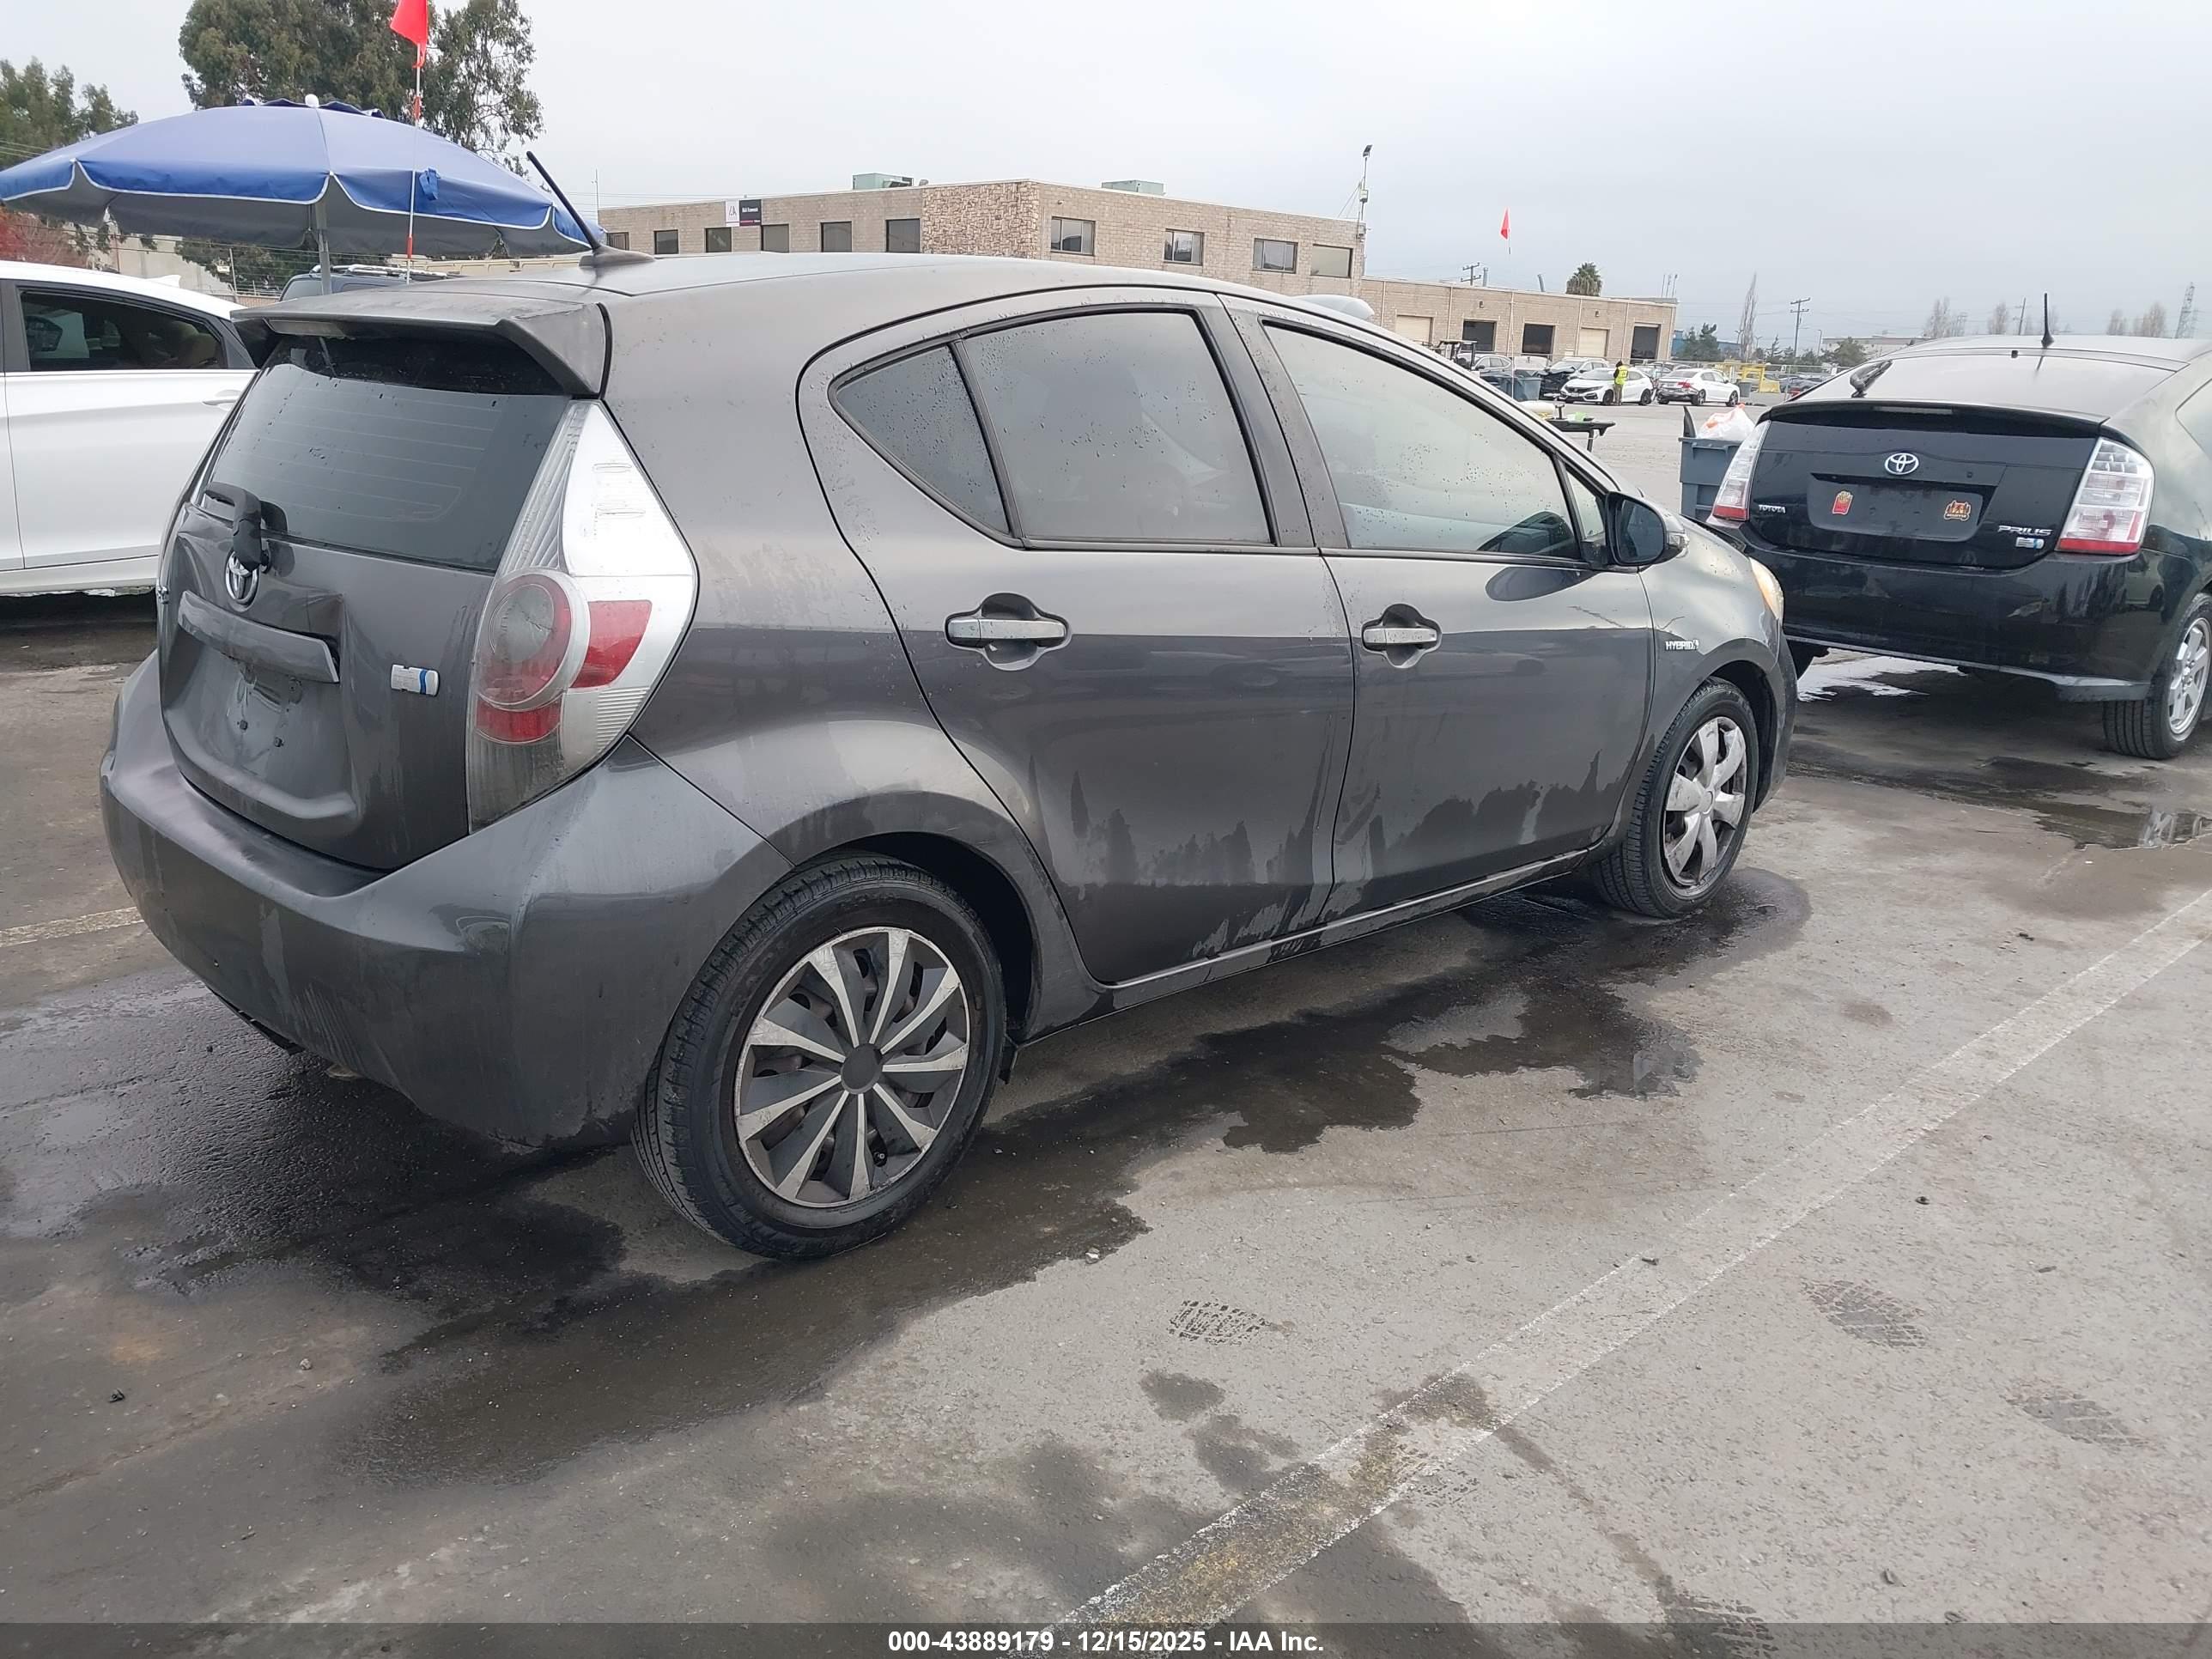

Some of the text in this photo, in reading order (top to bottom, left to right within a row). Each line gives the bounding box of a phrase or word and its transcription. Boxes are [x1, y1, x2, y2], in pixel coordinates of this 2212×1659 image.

[1758, 504, 1786, 514] TOYOTA
[1997, 525, 2054, 537] PRIUS
[1665, 641, 1696, 651] HYBRID
